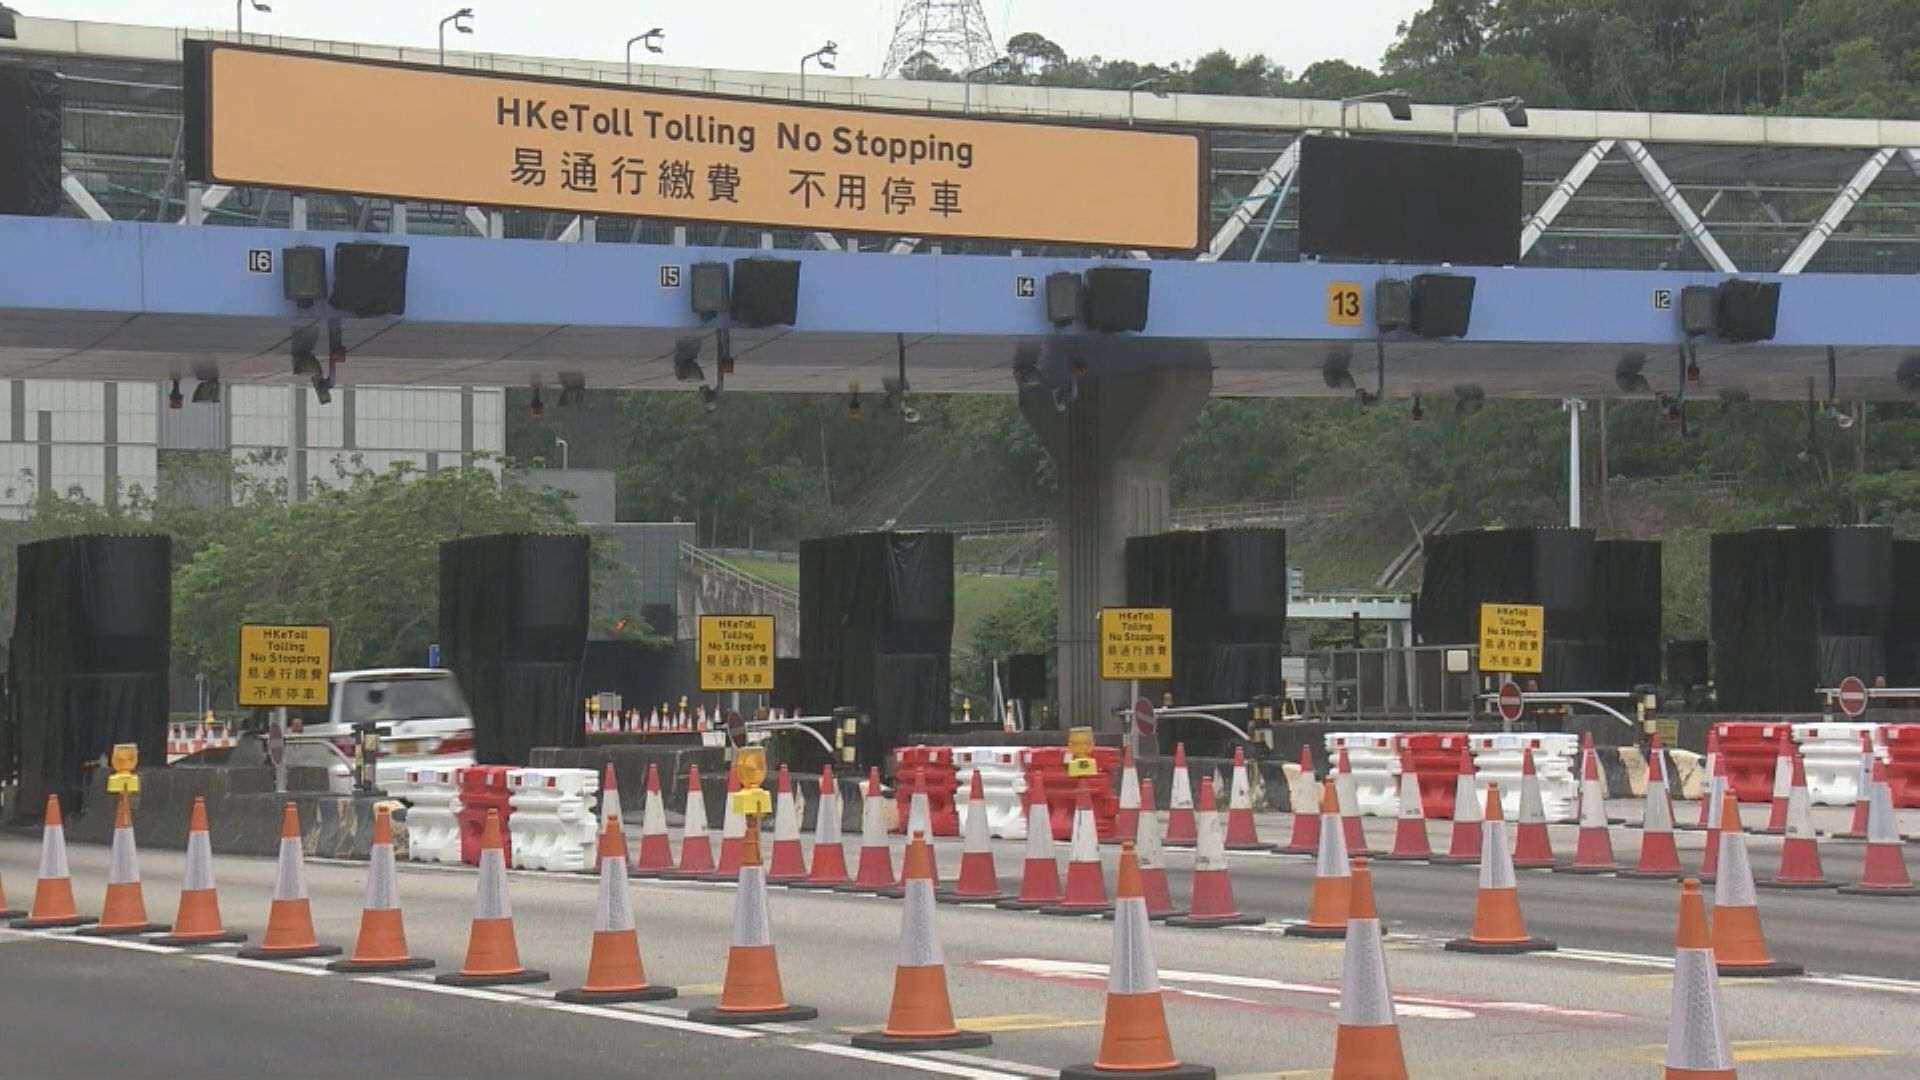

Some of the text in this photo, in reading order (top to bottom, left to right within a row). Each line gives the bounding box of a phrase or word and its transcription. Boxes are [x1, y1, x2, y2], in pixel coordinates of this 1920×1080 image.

[496, 96, 973, 169] HKeToll Tolling No Stopping
[511, 147, 964, 218] 易通行繳費 不用停車
[251, 252, 270, 271] 16
[662, 267, 678, 286] 15
[1019, 277, 1034, 295] 14
[1332, 291, 1360, 317] 13
[1656, 291, 1670, 308] 12
[263, 629, 308, 640] HKeToll
[268, 641, 305, 652] Tolling
[250, 653, 320, 665] No Stopping
